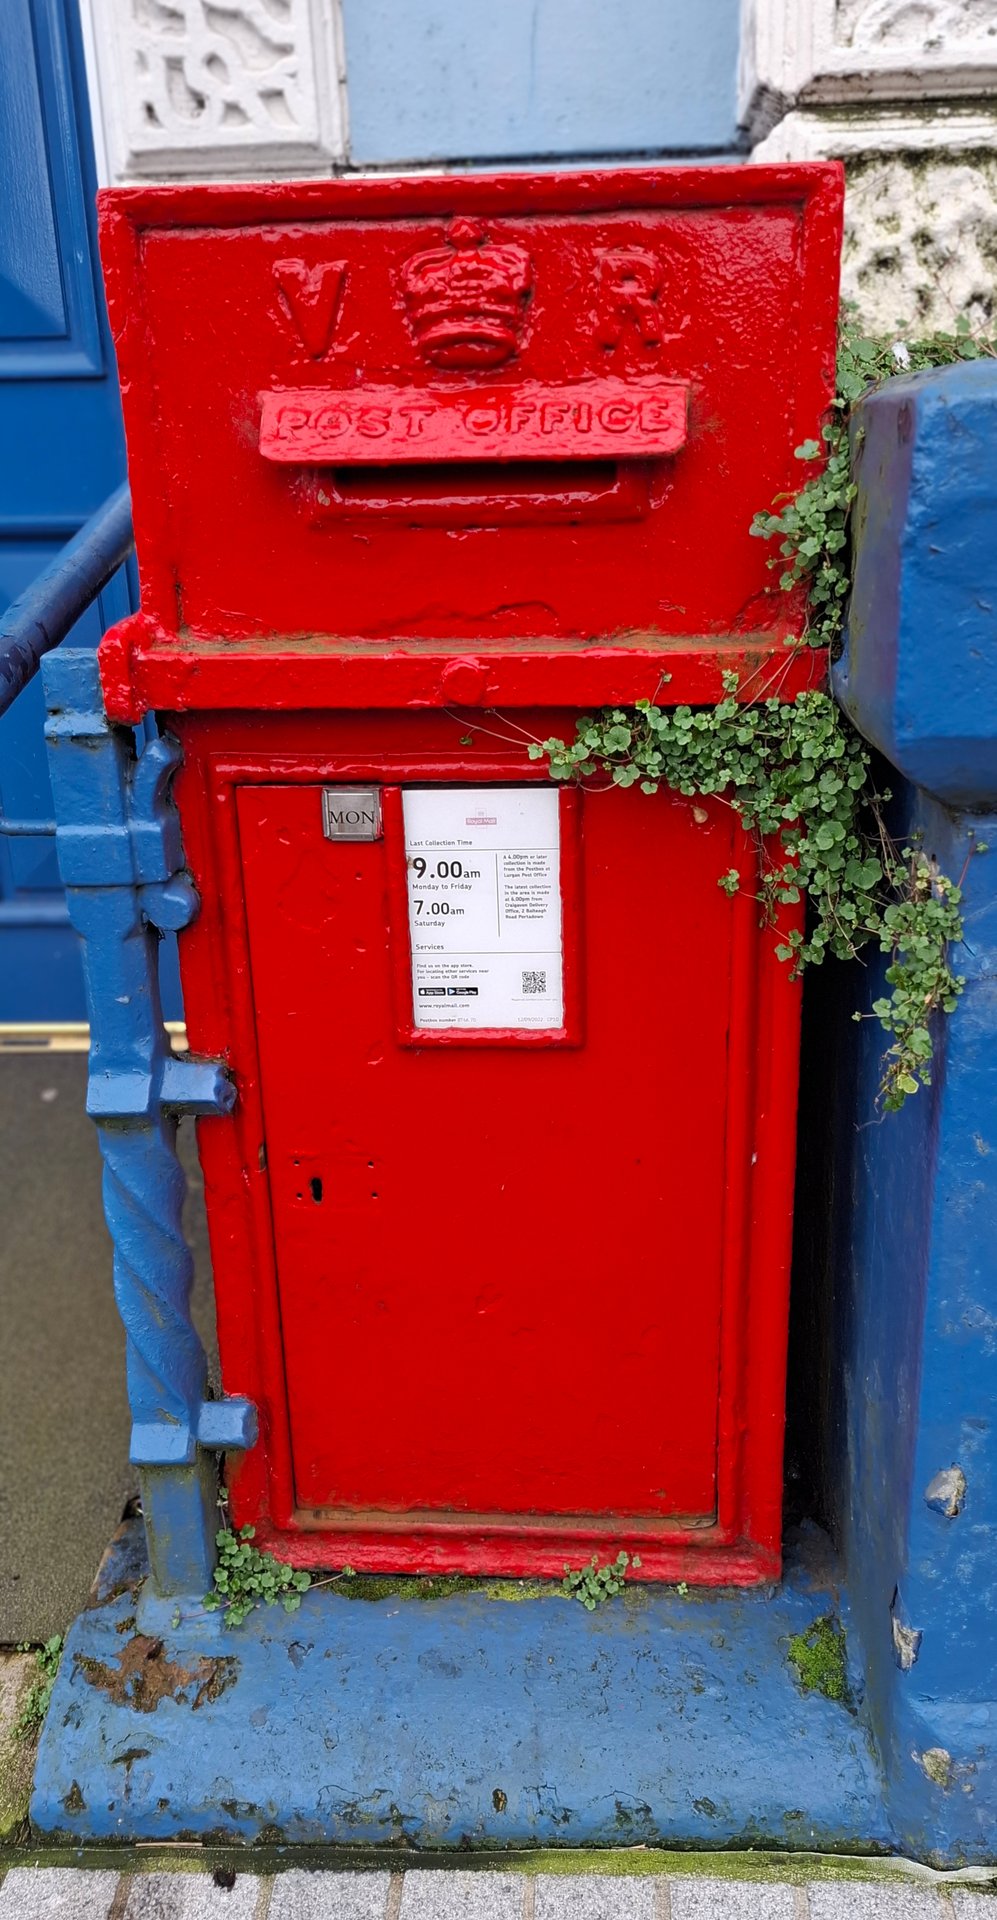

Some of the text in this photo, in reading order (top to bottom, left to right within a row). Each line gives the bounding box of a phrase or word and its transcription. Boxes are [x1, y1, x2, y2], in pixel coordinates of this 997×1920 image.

[272, 246, 665, 361] V R
[276, 400, 673, 441] POST OFFICE
[328, 810, 375, 825] MON
[412, 857, 480, 879] 9.00am
[413, 900, 465, 915] 7.00am
[414, 920, 445, 928] Saturday
